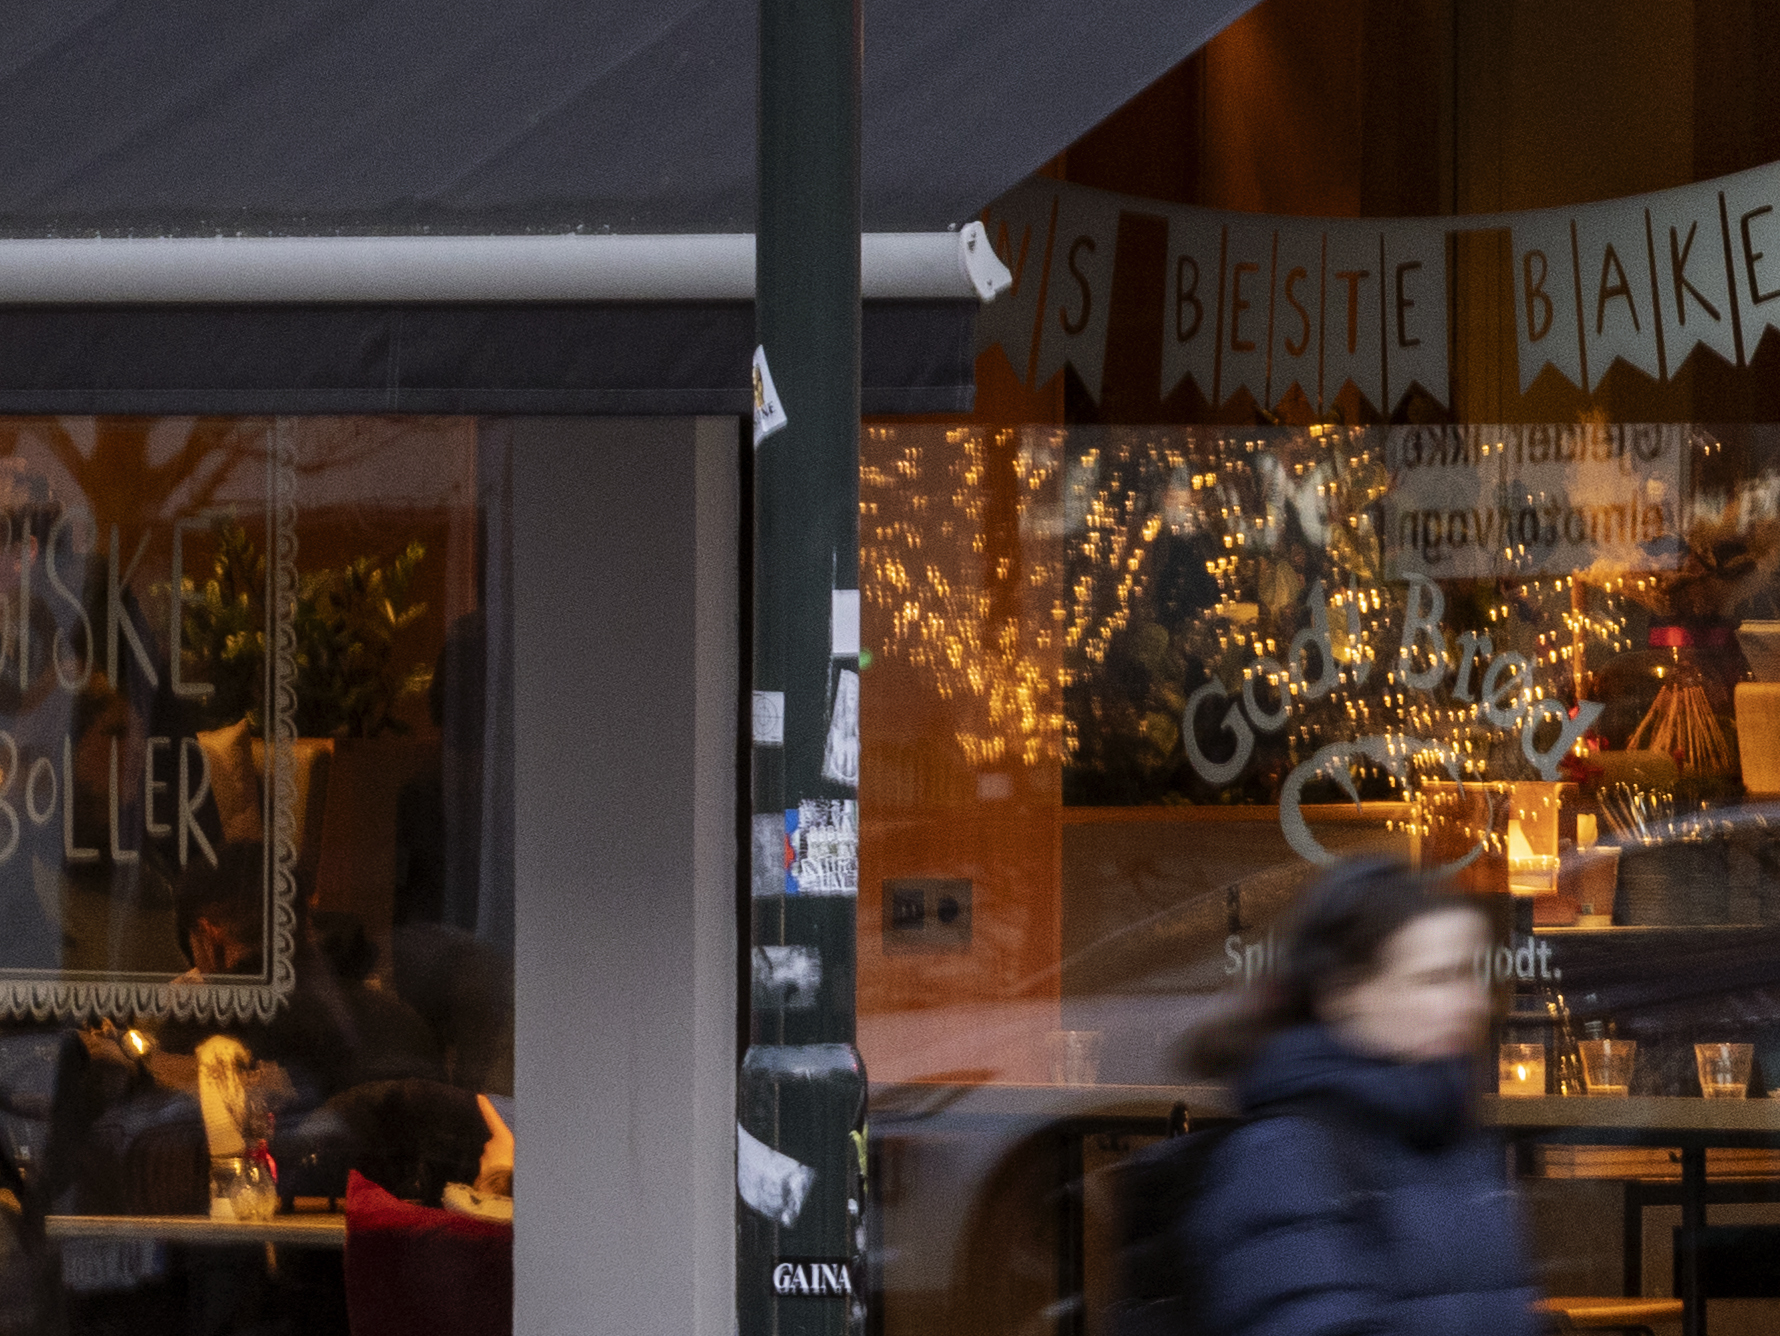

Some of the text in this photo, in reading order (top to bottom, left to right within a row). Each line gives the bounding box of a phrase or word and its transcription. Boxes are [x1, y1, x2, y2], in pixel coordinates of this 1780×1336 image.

[1174, 254, 1423, 357] BESTE
[1182, 570, 1606, 785] Godt Brød
[772, 1262, 852, 1297] GAINA
